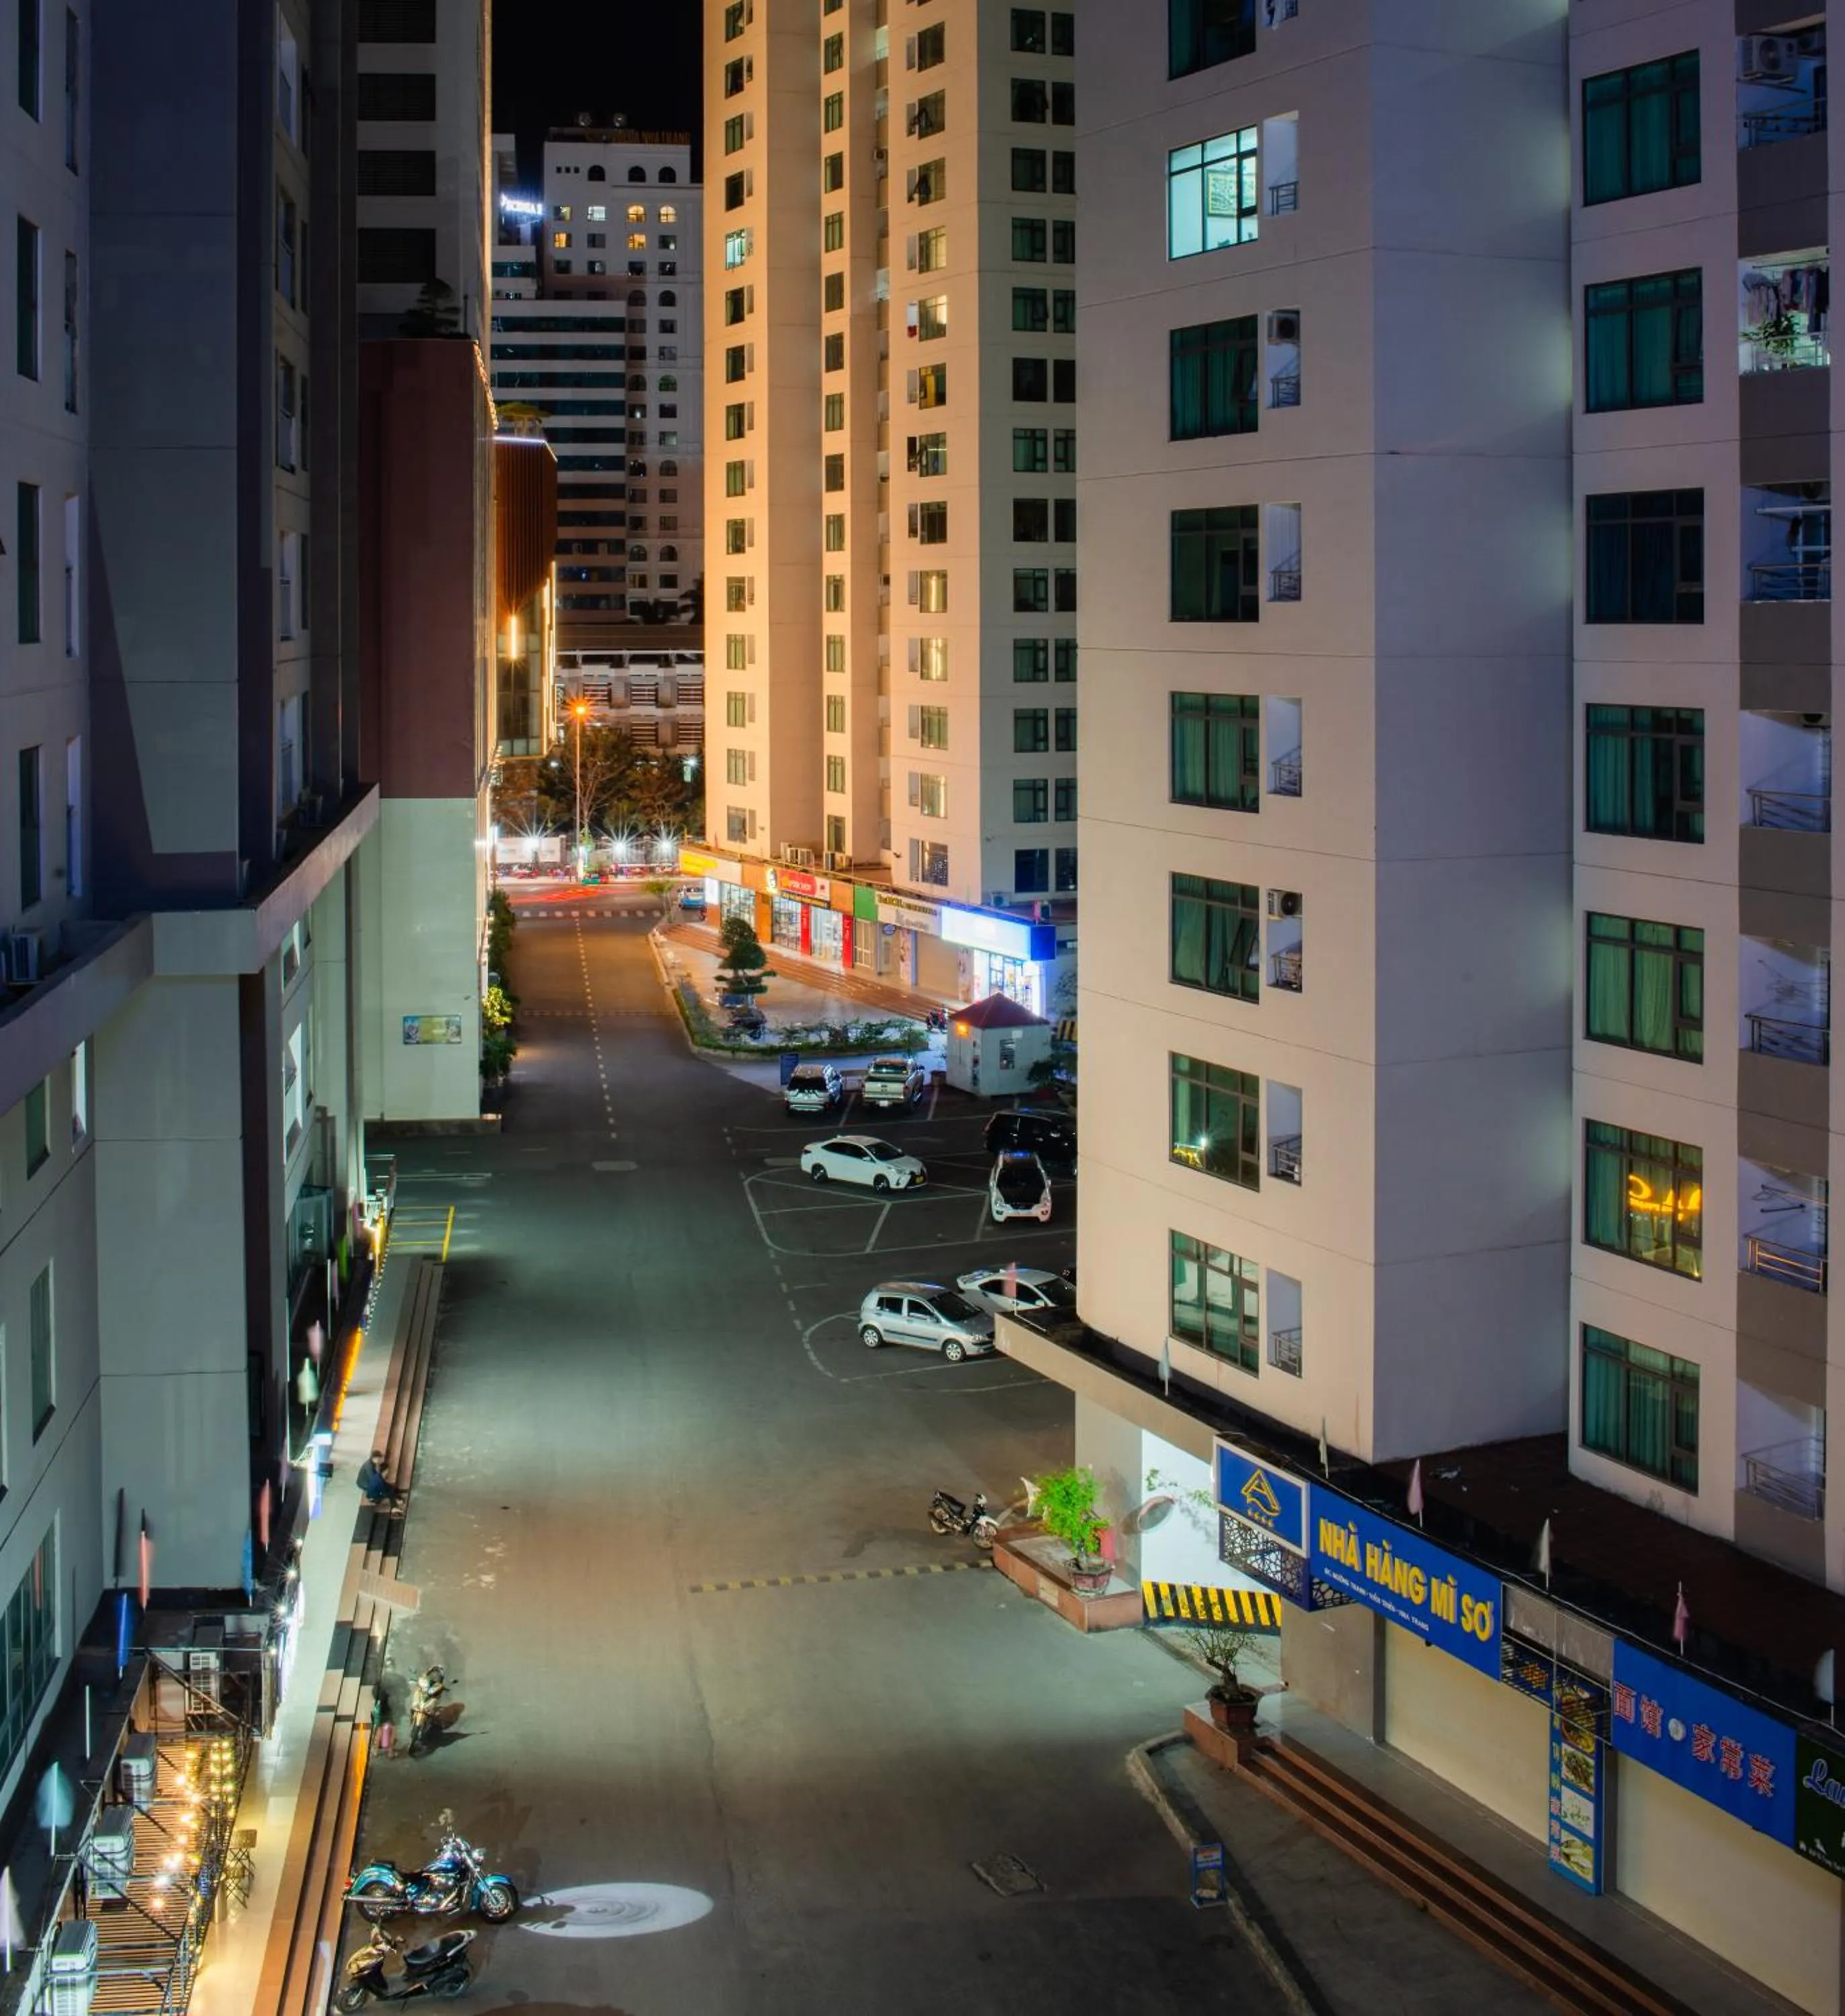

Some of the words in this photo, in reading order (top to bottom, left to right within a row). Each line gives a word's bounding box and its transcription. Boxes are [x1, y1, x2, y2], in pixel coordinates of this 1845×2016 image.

[1320, 1517, 1363, 1572] NHÀ
[1366, 1539, 1428, 1605] HÀNG
[1431, 1574, 1457, 1624] MÌ
[1461, 1593, 1494, 1642] SƠ
[1692, 1722, 1776, 1798] 家常菜
